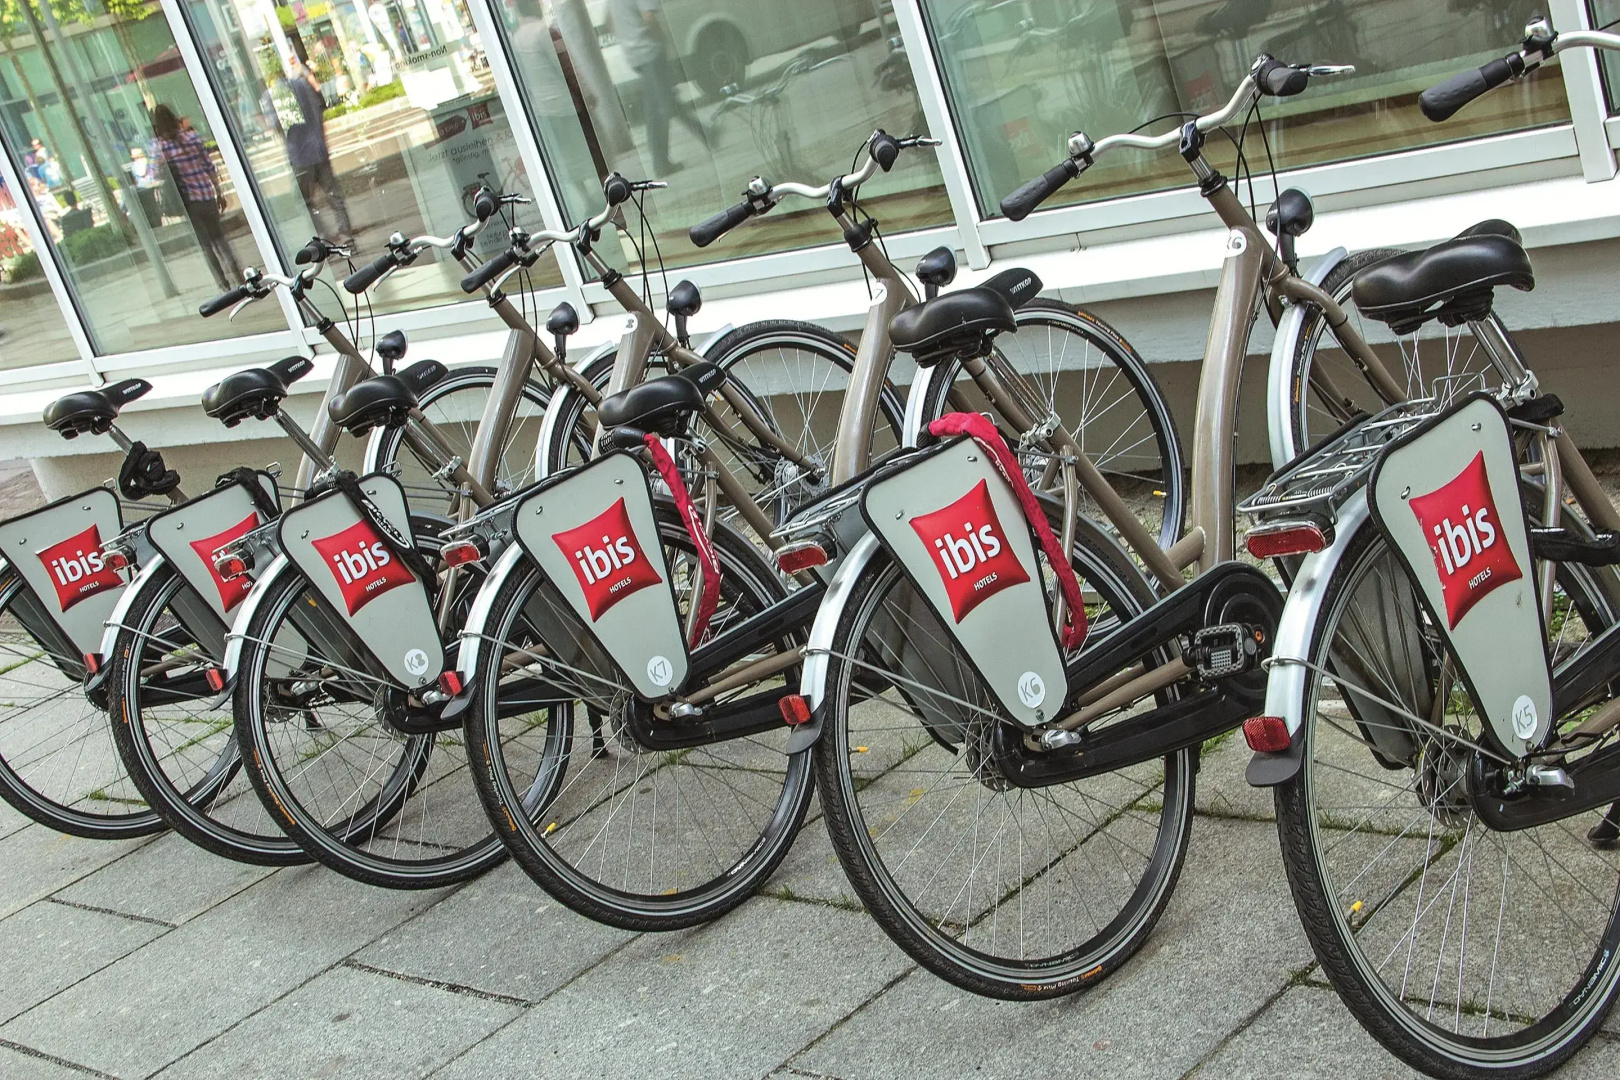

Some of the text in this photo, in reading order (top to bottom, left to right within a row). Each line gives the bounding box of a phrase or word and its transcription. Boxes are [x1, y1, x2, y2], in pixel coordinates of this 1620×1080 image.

[471, 110, 488, 122] ibis
[450, 136, 494, 156] ausleihen
[1009, 276, 1032, 295] WITTKOP
[934, 522, 1001, 580] ibis
[1433, 504, 1496, 576] ibis
[51, 550, 104, 586] ibis
[333, 541, 391, 585] ibis
[574, 535, 635, 586] ibis
[79, 580, 100, 593] HOTELS
[365, 576, 387, 592] HOTELS
[609, 576, 632, 594] HOTELS
[973, 571, 998, 591] HOTELS
[1468, 566, 1492, 590] HOTELS
[406, 653, 426, 671] K8
[649, 660, 667, 683] K7
[1020, 677, 1041, 702] K6
[1515, 704, 1533, 733] K5
